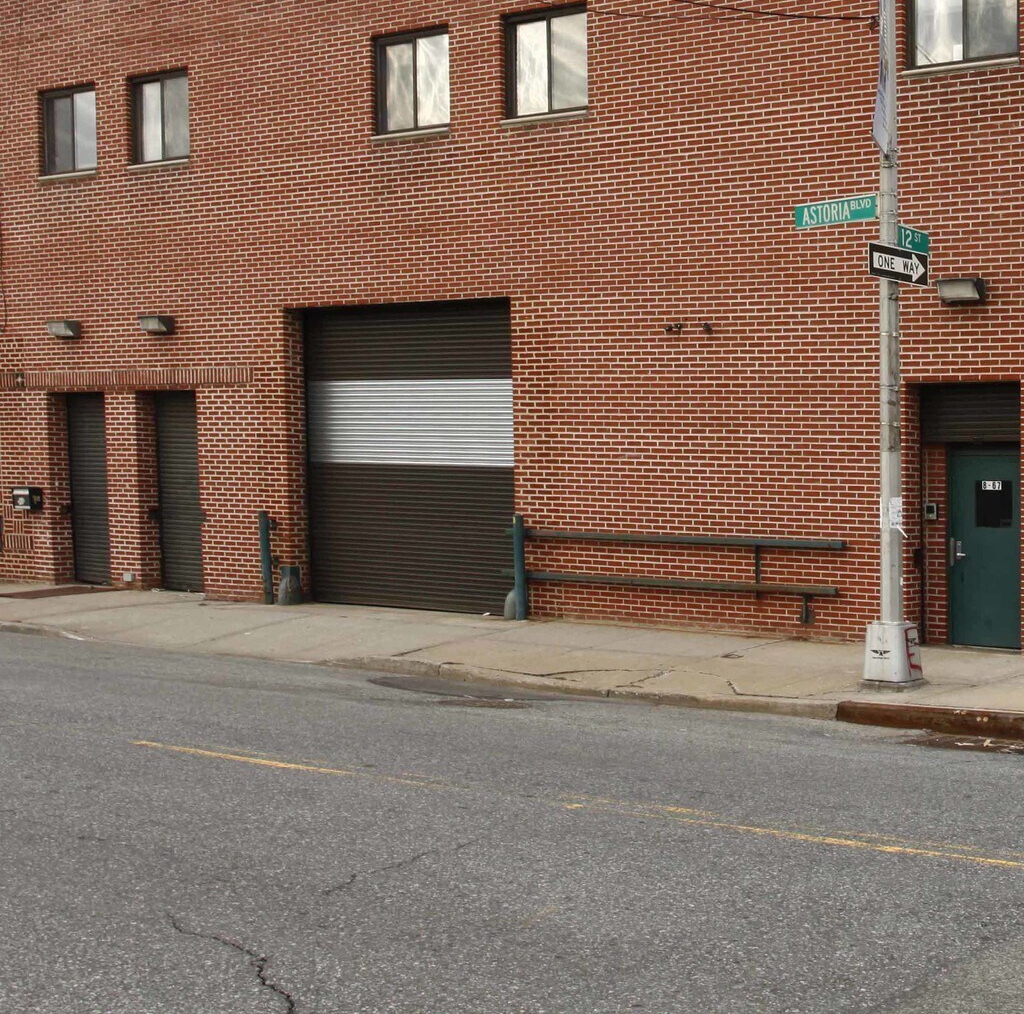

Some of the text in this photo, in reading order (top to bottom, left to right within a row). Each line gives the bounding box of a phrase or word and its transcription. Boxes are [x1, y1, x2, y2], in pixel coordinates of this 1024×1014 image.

[802, 198, 872, 226] ASTORIA BLVD
[901, 228, 922, 249] 12 ST
[877, 254, 920, 274] ONE WAY
